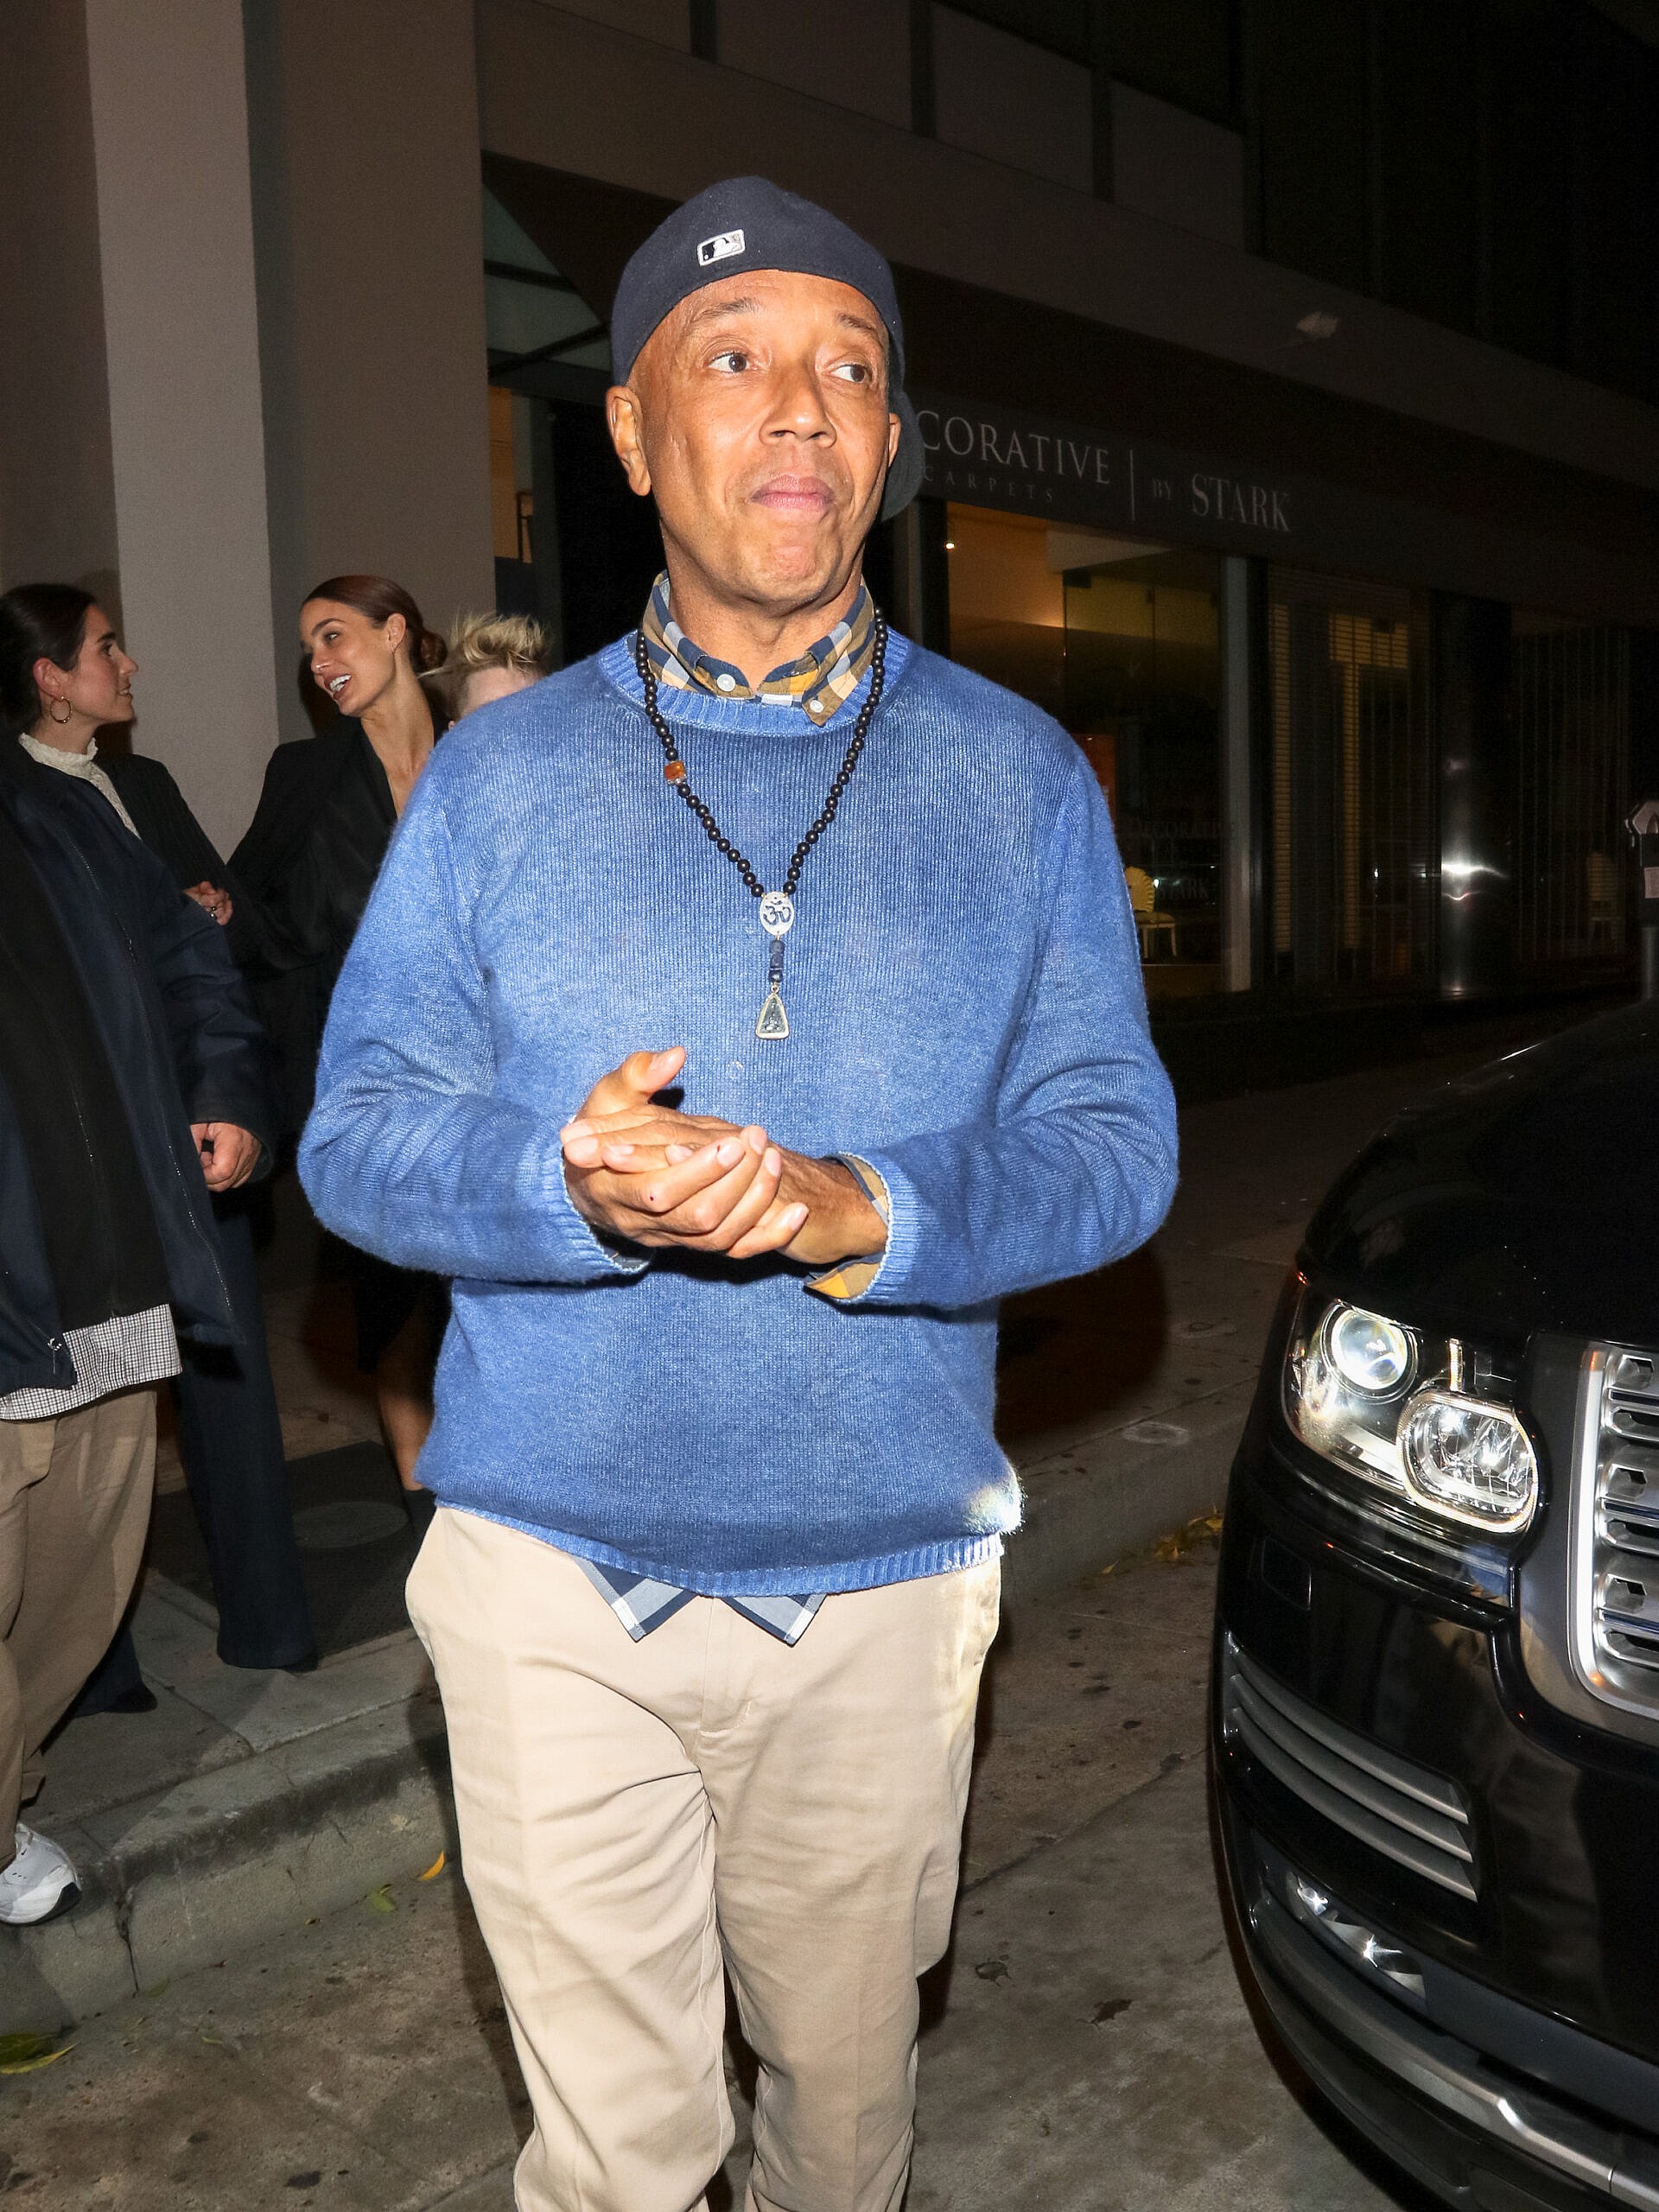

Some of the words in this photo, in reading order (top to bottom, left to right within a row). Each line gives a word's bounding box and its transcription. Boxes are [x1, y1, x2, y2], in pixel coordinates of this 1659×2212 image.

[917, 410, 1111, 485] CORATIVE
[1153, 477, 1173, 501] BY
[1191, 472, 1292, 533] STARK
[925, 466, 1054, 504] CARPETS
